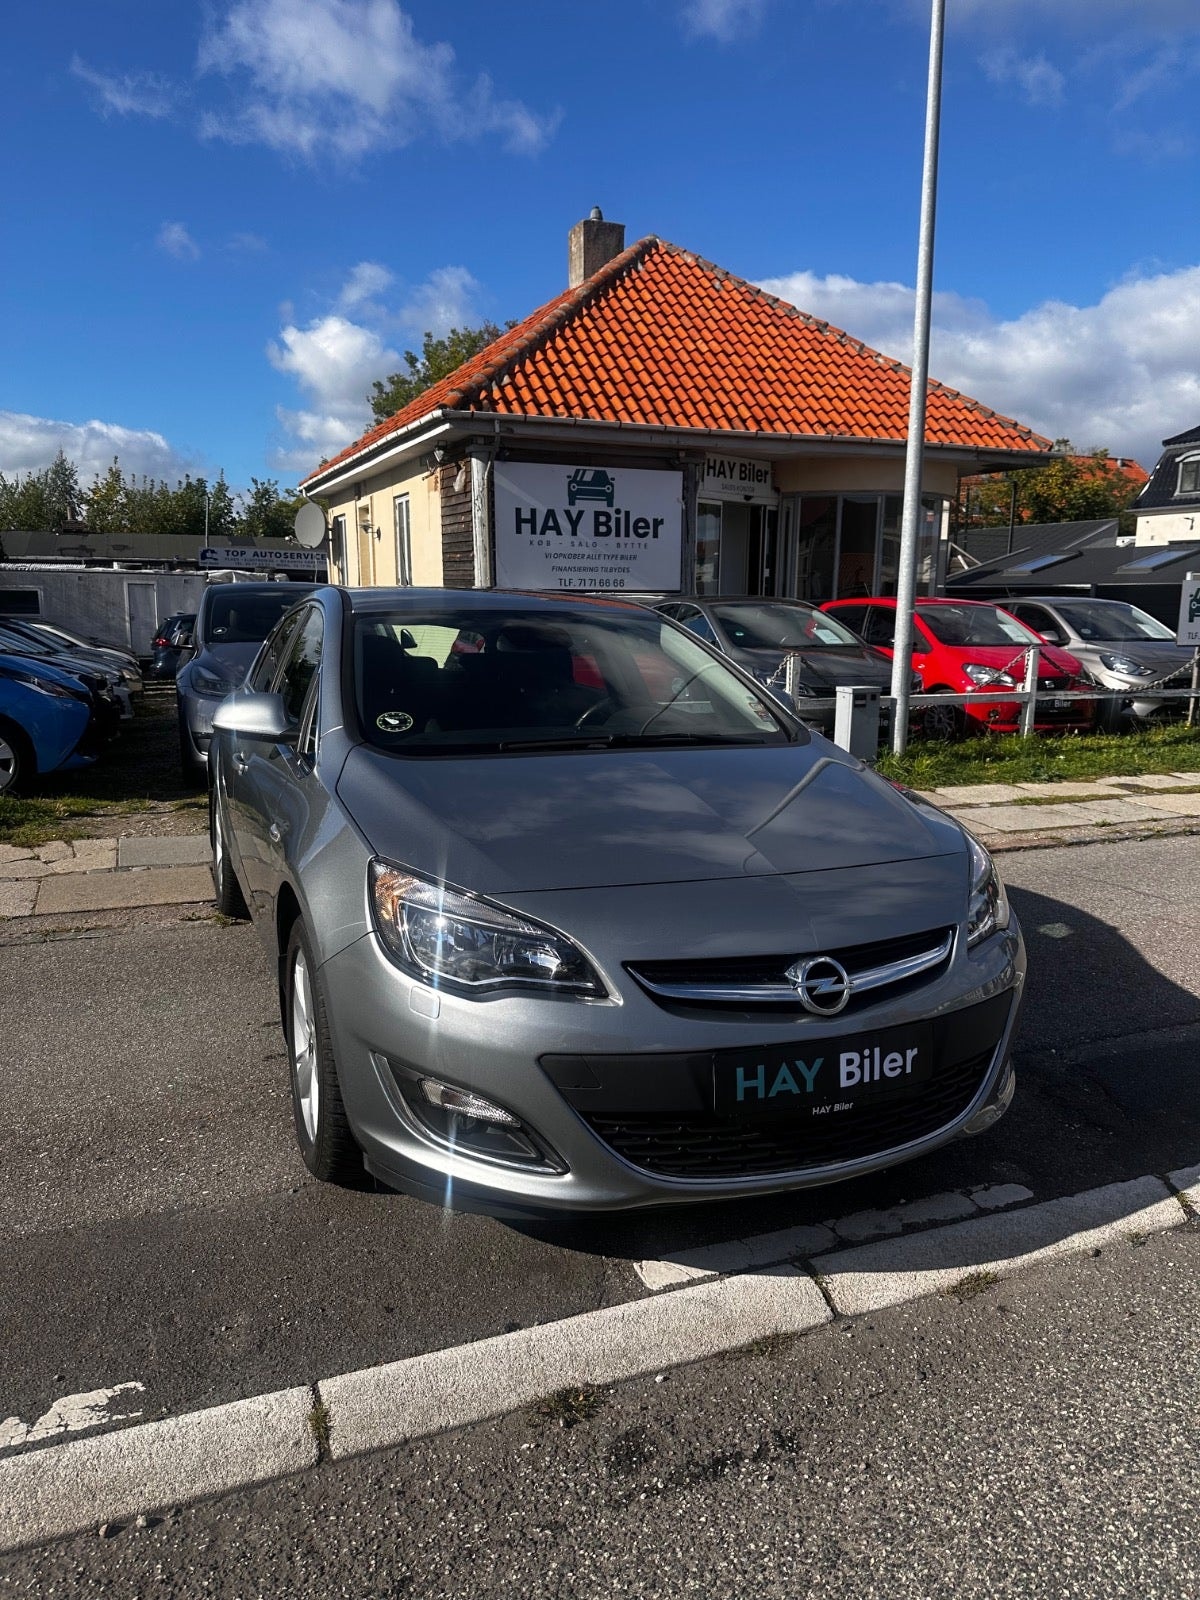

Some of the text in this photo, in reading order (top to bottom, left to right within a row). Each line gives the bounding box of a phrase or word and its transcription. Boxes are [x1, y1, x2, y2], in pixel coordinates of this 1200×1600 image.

[706, 458, 769, 484] HAY Biler
[515, 507, 664, 539] HAY Biler
[529, 539, 551, 547] KØB
[224, 549, 327, 560] TOP AUTOSERVICE
[551, 565, 599, 573] FINANSIERING
[558, 578, 625, 588] TLF. 71 71 66 66
[1054, 699, 1072, 708] Biler
[736, 1046, 918, 1101] HAY Biler
[812, 1102, 854, 1116] HAY Biler
